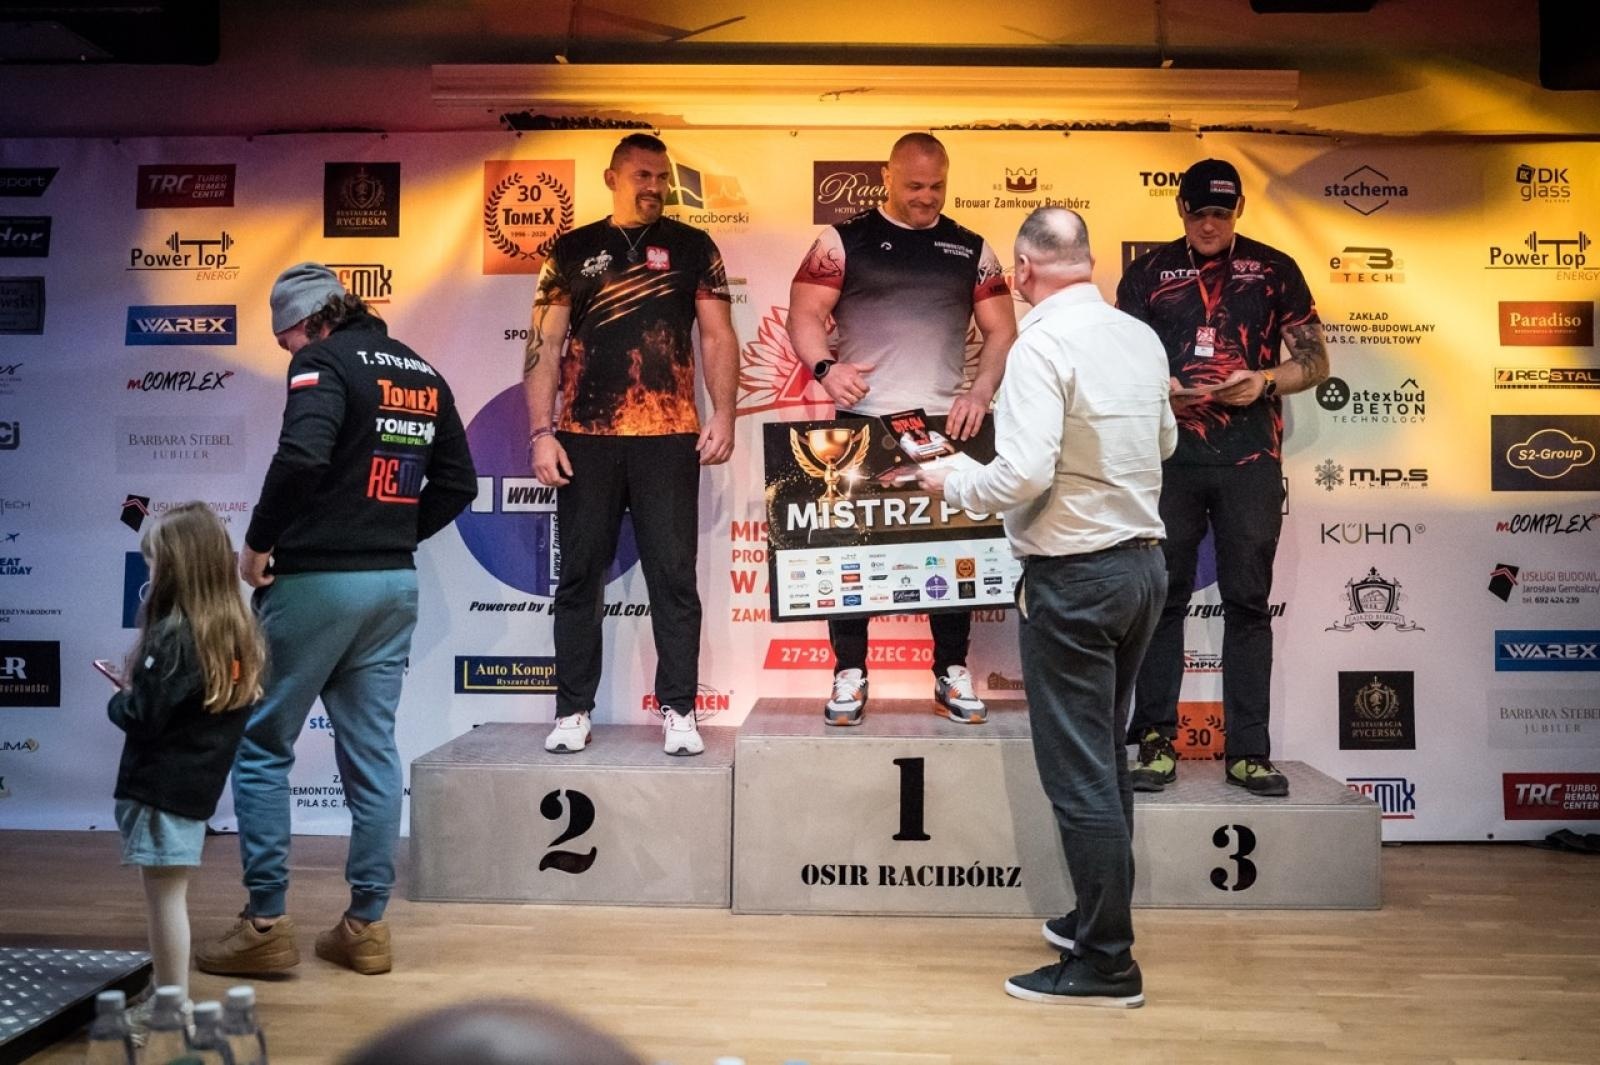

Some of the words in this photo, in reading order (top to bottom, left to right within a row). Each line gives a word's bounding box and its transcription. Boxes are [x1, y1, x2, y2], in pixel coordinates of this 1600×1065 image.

[1538, 168, 1569, 183] DK
[148, 174, 194, 194] TRC
[1324, 181, 1408, 197] stachema
[517, 185, 542, 202] 30
[1520, 184, 1571, 202] glass
[954, 197, 990, 209] Browar
[994, 197, 1042, 209] Zamkowy
[336, 217, 388, 226] RYCERSKA
[689, 212, 749, 223] raciborski
[131, 248, 191, 267] Power
[1490, 247, 1549, 266] Power
[196, 271, 240, 281] ENERGY
[1344, 273, 1394, 282] TECH
[1556, 271, 1600, 281] ENERGY
[1349, 312, 1389, 321] ZAKŁAD
[1510, 312, 1582, 327] Paradiso
[135, 318, 227, 333] WAREX
[504, 330, 528, 341] SPO
[1360, 336, 1421, 344] RYDUŁTOWY
[357, 351, 374, 365] T.
[127, 371, 227, 392] mCOMPLEX
[1515, 370, 1600, 381] RECSTAL
[1352, 390, 1425, 402] atexbud
[1353, 403, 1425, 415] BETON
[128, 433, 187, 446] BARBARA
[190, 433, 233, 446] STEBEL
[1518, 448, 1583, 462] S2-Group
[367, 457, 418, 498] REM
[1349, 468, 1428, 486] m.p.s
[786, 496, 931, 531] MISTRZ
[1496, 513, 1592, 534] mCOMPLEX
[732, 549, 768, 563] PRO
[730, 571, 757, 594] W
[1522, 571, 1556, 582] USŁUGI
[469, 601, 526, 612] Powered
[528, 601, 544, 613] by
[731, 608, 770, 622] ZAM
[781, 648, 830, 663] 27-29
[911, 647, 933, 662] 20
[1504, 644, 1598, 659] WAREX
[476, 663, 508, 676] Auto
[512, 663, 556, 679] Kompl
[497, 677, 530, 687] Ryszard
[1500, 707, 1557, 719] BARBARA
[309, 716, 334, 730] sta
[1524, 724, 1582, 734] JUBILER
[1186, 729, 1211, 746] 30
[1351, 728, 1403, 737] RYCERSKA
[892, 756, 931, 842] 1
[1515, 784, 1563, 806] TRC
[1565, 784, 1597, 792] TURBO
[1564, 792, 1599, 801] REMAN
[297, 799, 319, 808] PIŁA
[1563, 801, 1599, 810] CENTER
[538, 788, 598, 875] 2
[1210, 824, 1257, 892] 3
[800, 863, 869, 888] OSIR
[878, 859, 1022, 888] RACIBÓRZ
